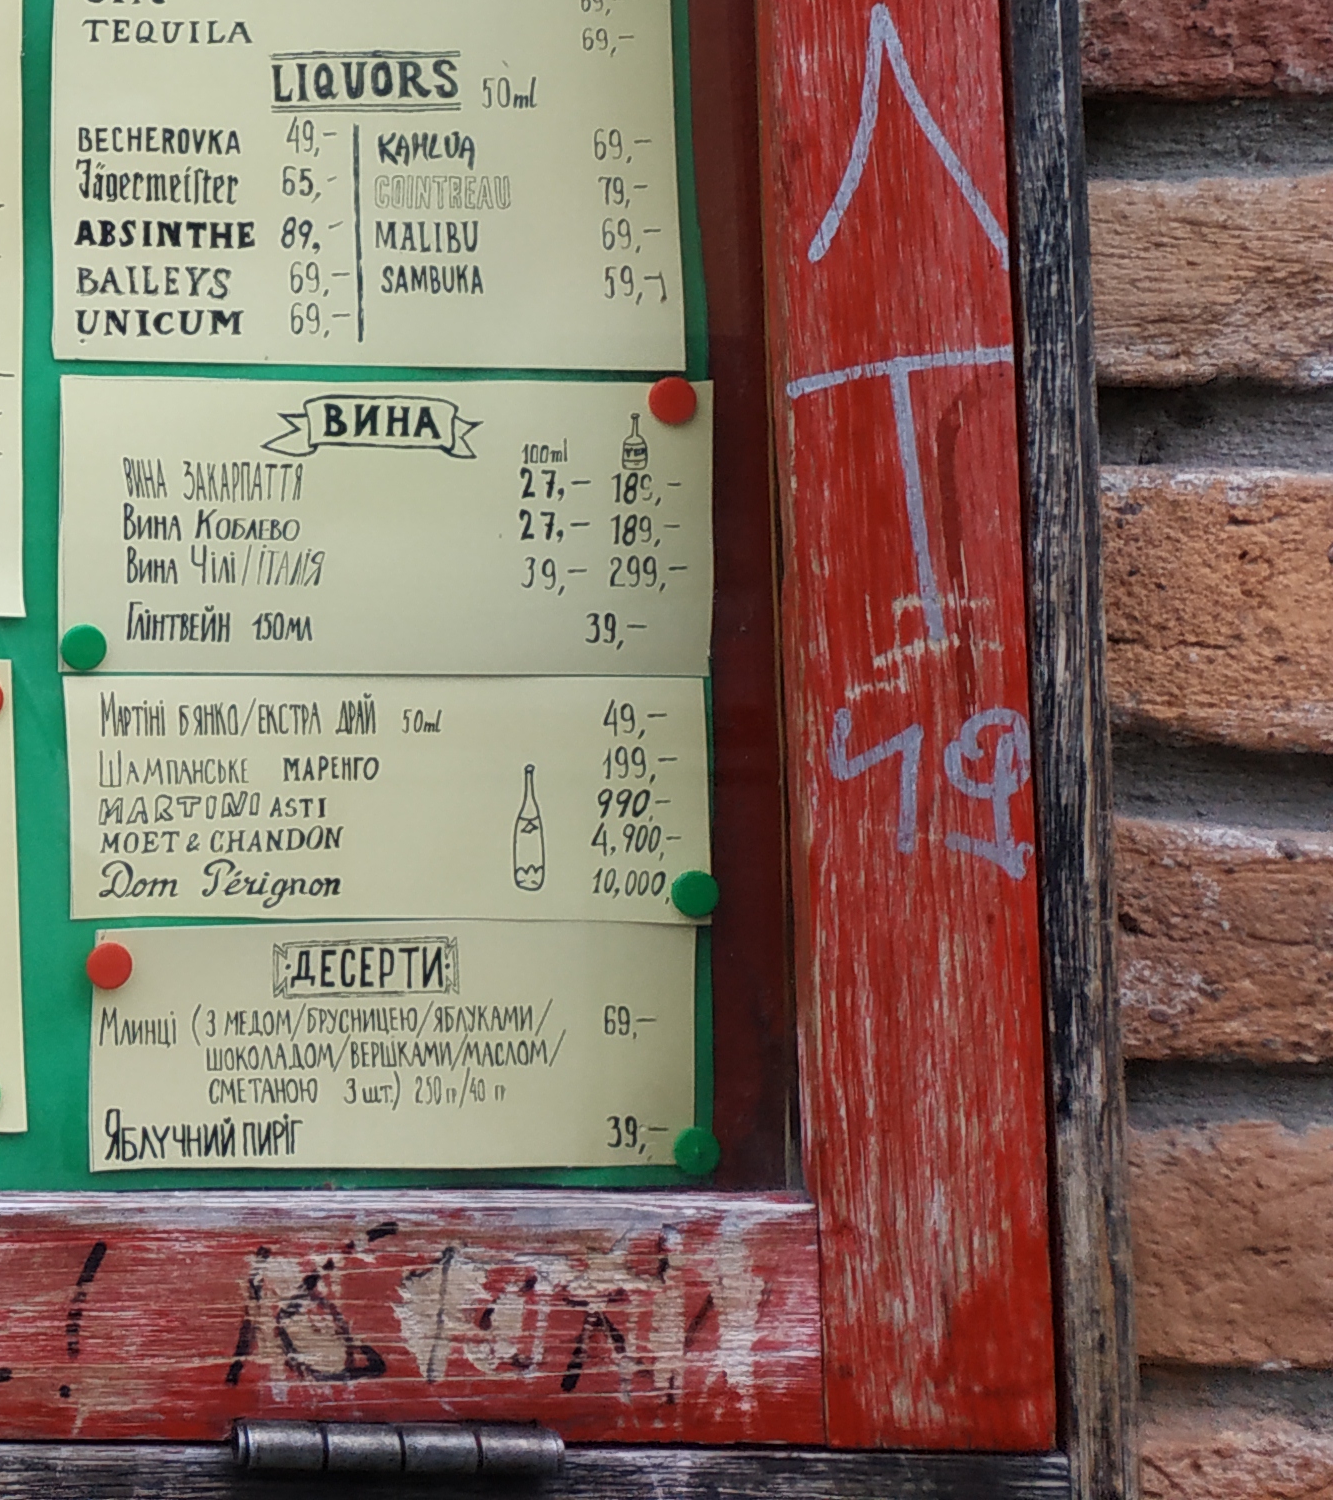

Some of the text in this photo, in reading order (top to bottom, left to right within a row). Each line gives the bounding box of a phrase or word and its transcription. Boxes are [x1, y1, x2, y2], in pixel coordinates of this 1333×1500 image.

[82, 19, 252, 44] TEQUILA
[272, 59, 458, 102] LIQUORS
[78, 127, 240, 155] BECHEROVKA
[75, 220, 478, 253] ABSINTHE MALIBU
[76, 265, 483, 300] BAILEYS SAMBUKA
[76, 309, 243, 336] UNICUM
[324, 403, 441, 439] ВИНА
[283, 755, 379, 781] МАРЕНГО
[269, 797, 326, 818] ASTI
[100, 831, 180, 854] MOET
[210, 825, 343, 853] CHANDON
[99, 860, 178, 898] Dom
[290, 946, 443, 989] ДЕСЕРТИ
